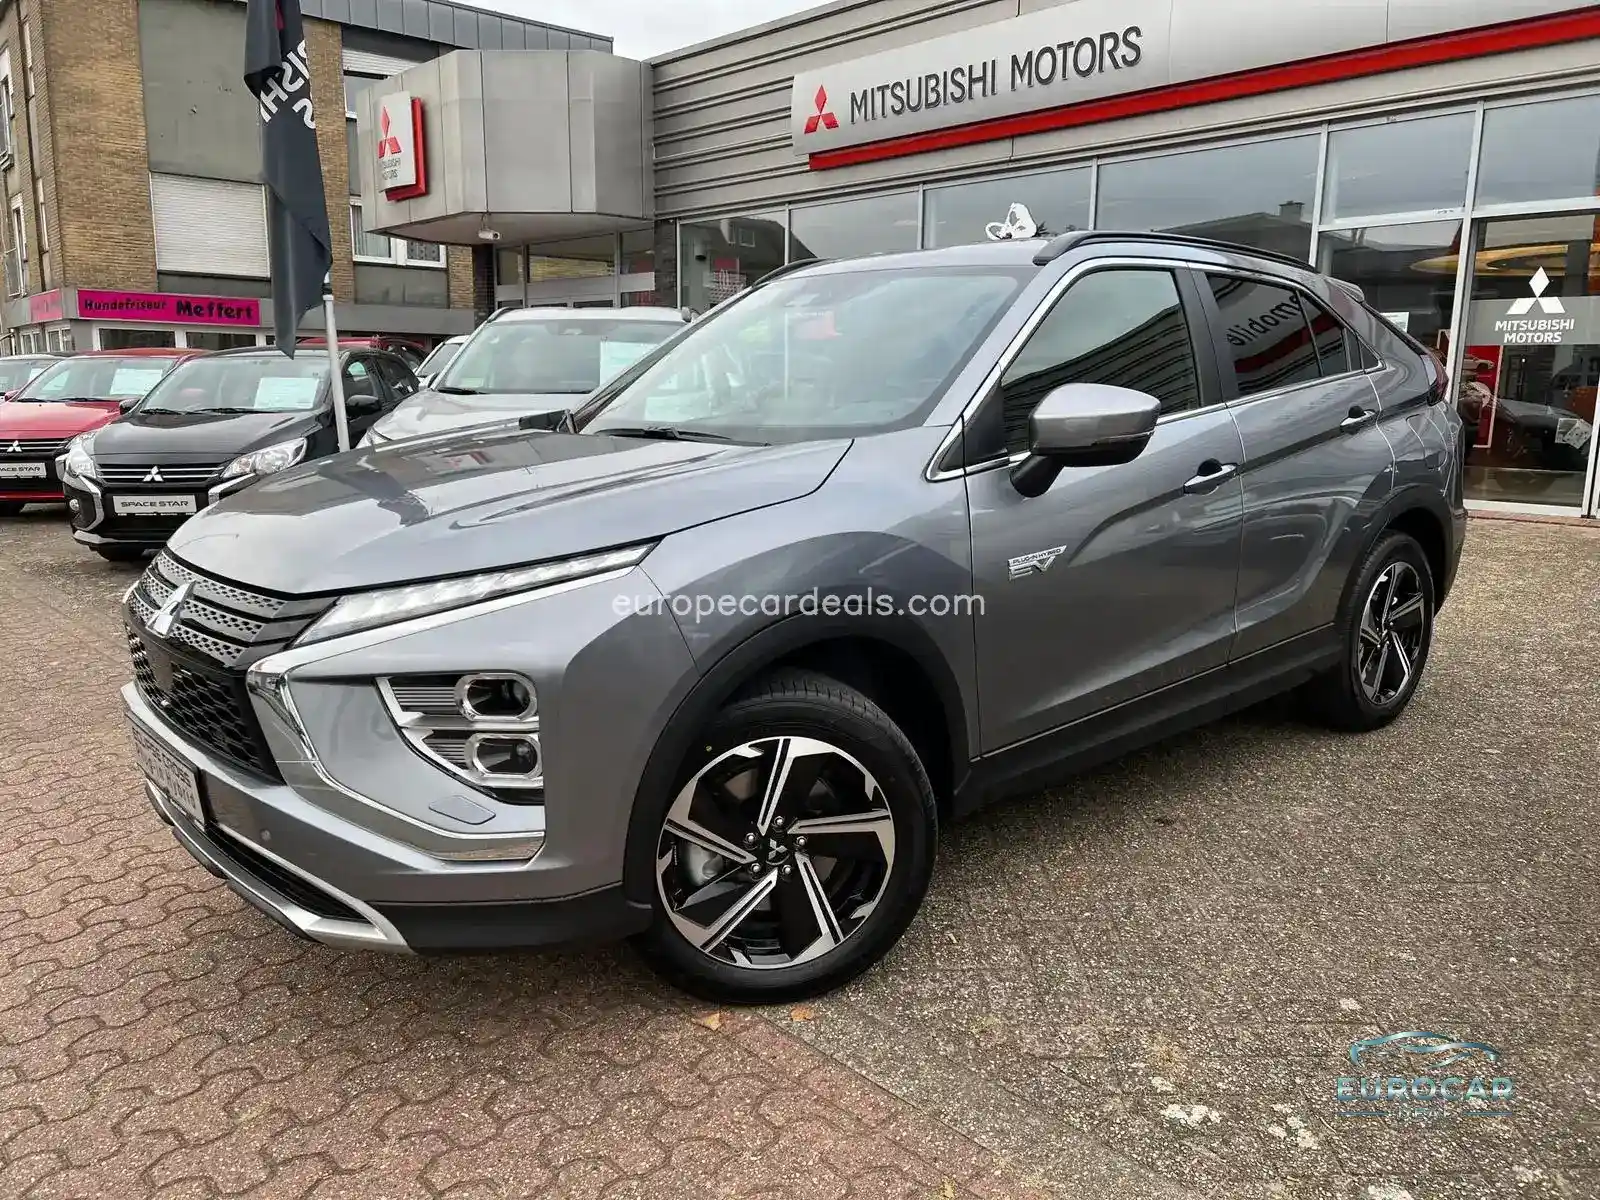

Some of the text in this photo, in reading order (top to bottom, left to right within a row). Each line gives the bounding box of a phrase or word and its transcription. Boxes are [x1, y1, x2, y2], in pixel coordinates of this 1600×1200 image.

[849, 25, 1143, 125] MITSUBISHI MOTORS
[84, 299, 253, 319] Hundefriseur Meffert
[1495, 318, 1575, 331] MITSUBISHI
[1504, 332, 1562, 343] MOTORS
